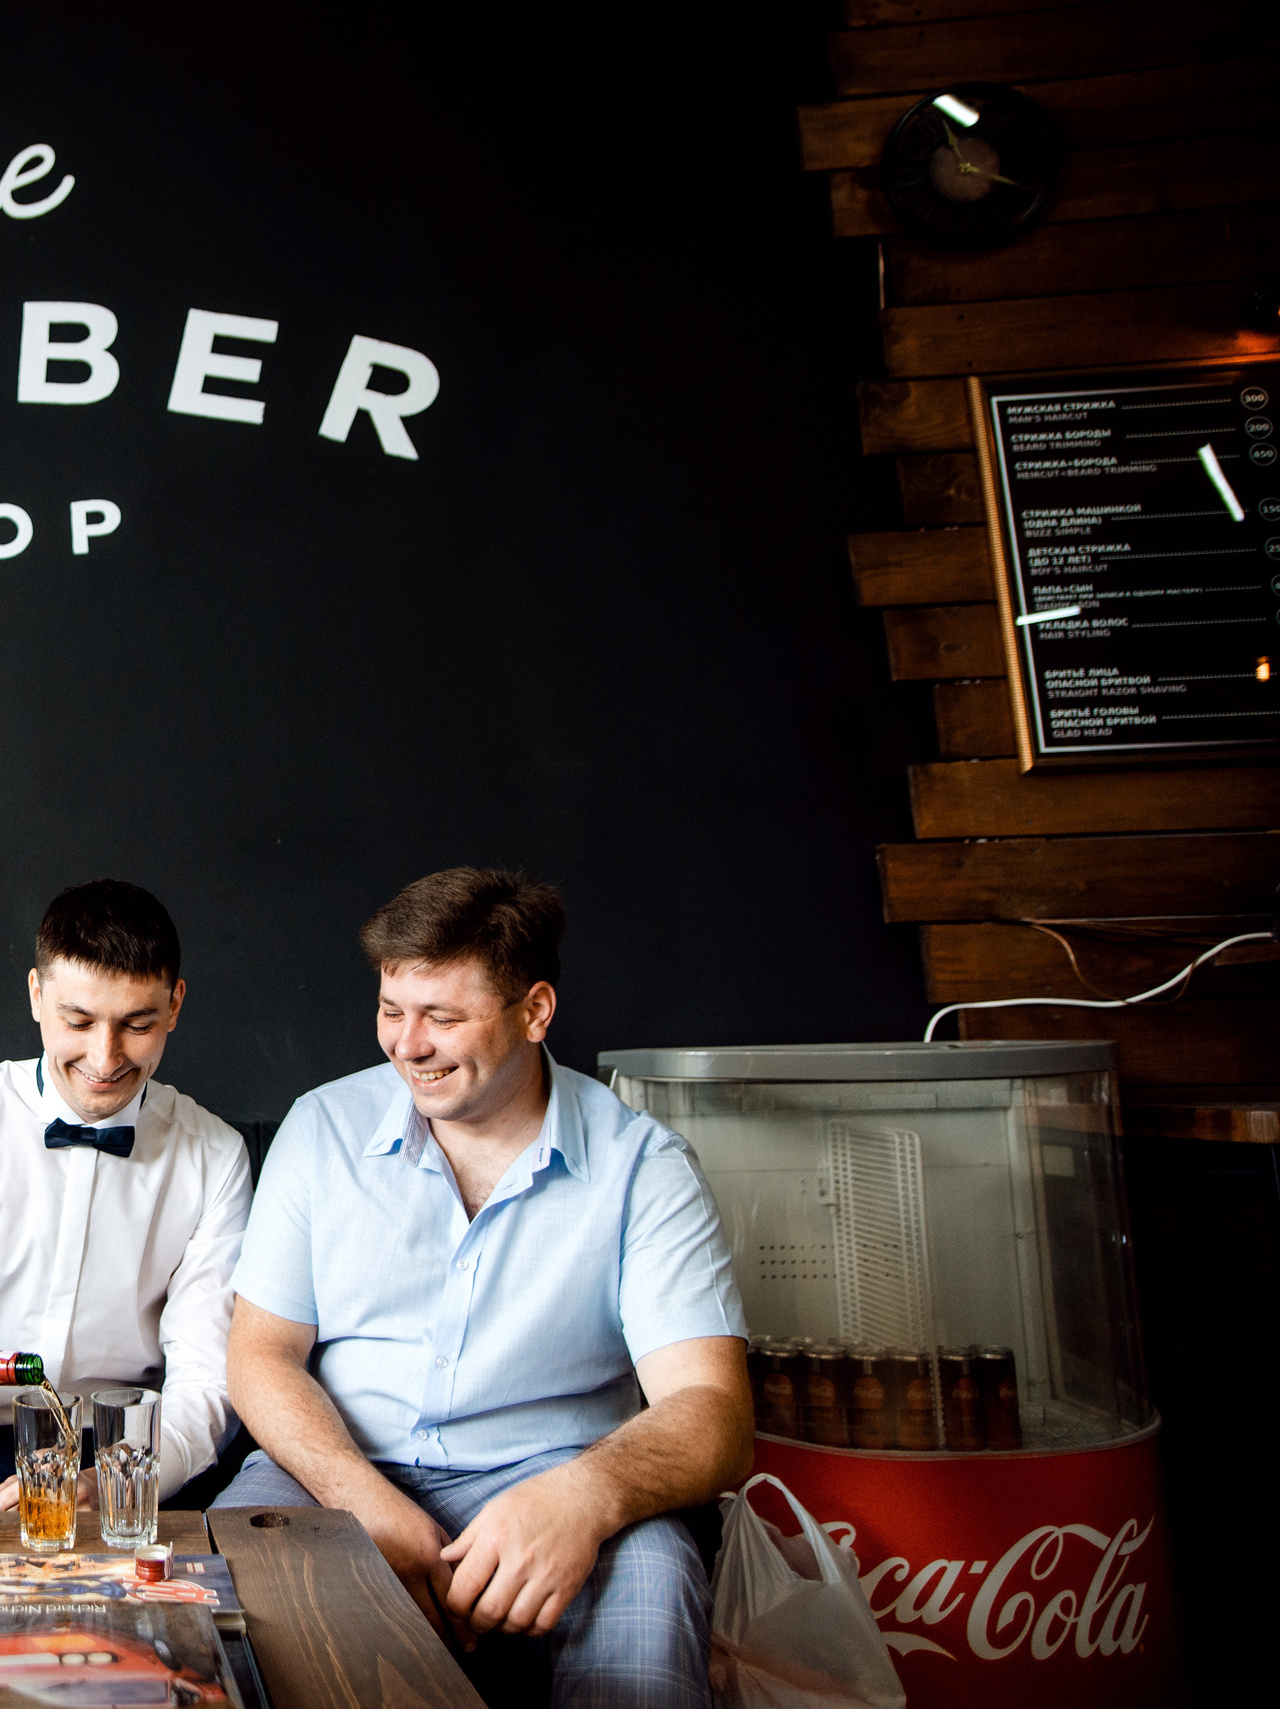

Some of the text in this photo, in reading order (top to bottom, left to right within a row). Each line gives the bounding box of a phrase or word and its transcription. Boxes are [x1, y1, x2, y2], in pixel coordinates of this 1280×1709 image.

[1044, 411, 1088, 421] HAIRCUT
[1052, 556, 1064, 565] 12
[46, 1604, 107, 1615] Richard
